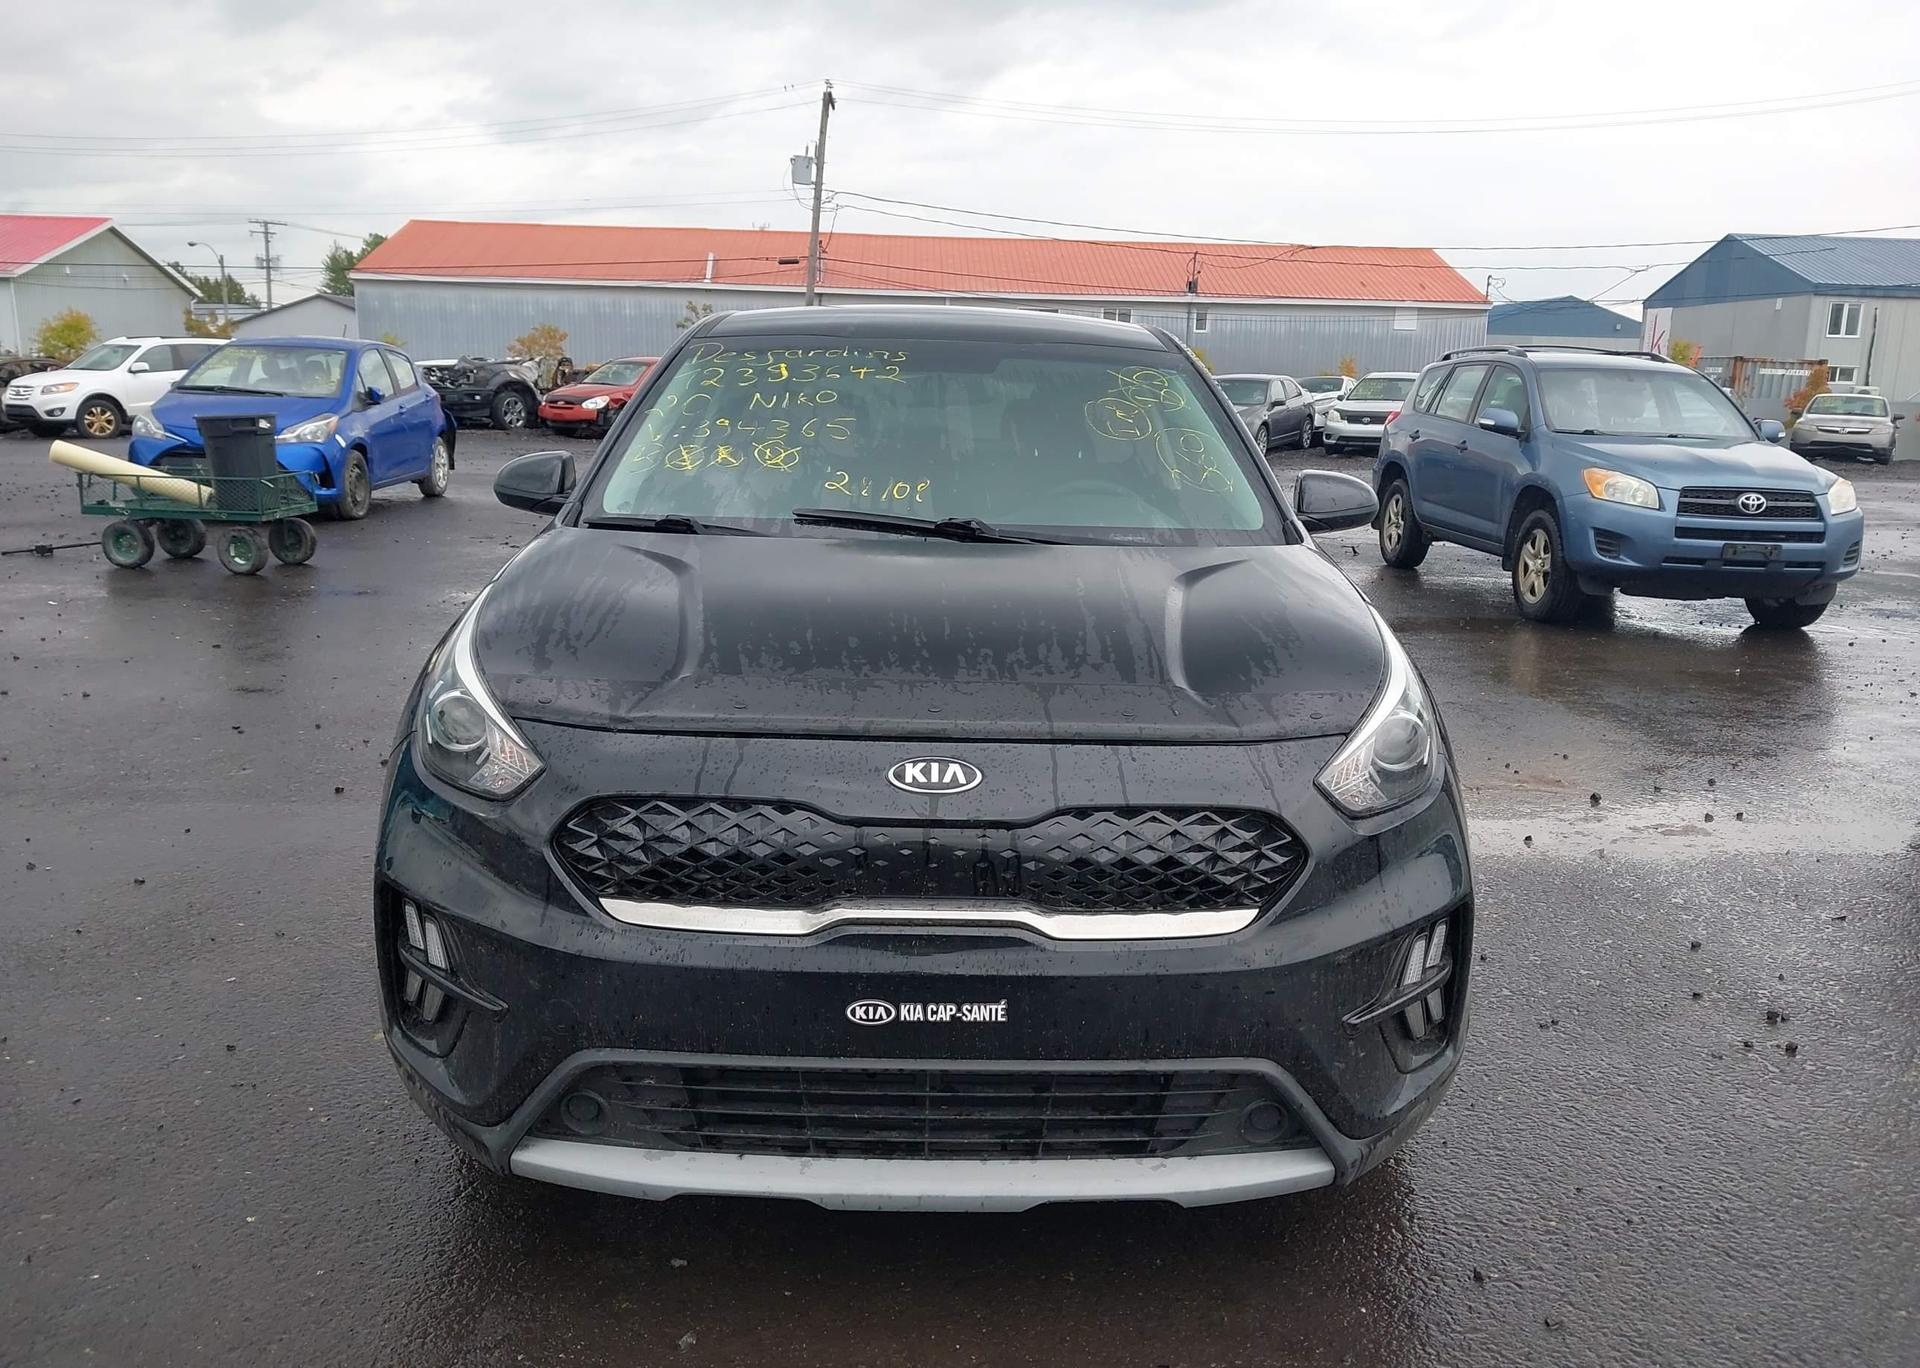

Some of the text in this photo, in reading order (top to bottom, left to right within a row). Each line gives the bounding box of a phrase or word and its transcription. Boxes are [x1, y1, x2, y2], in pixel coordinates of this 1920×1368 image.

[904, 762, 967, 785] KIA
[854, 1000, 1008, 1022] KIA KIA CAP-SANTÉ
